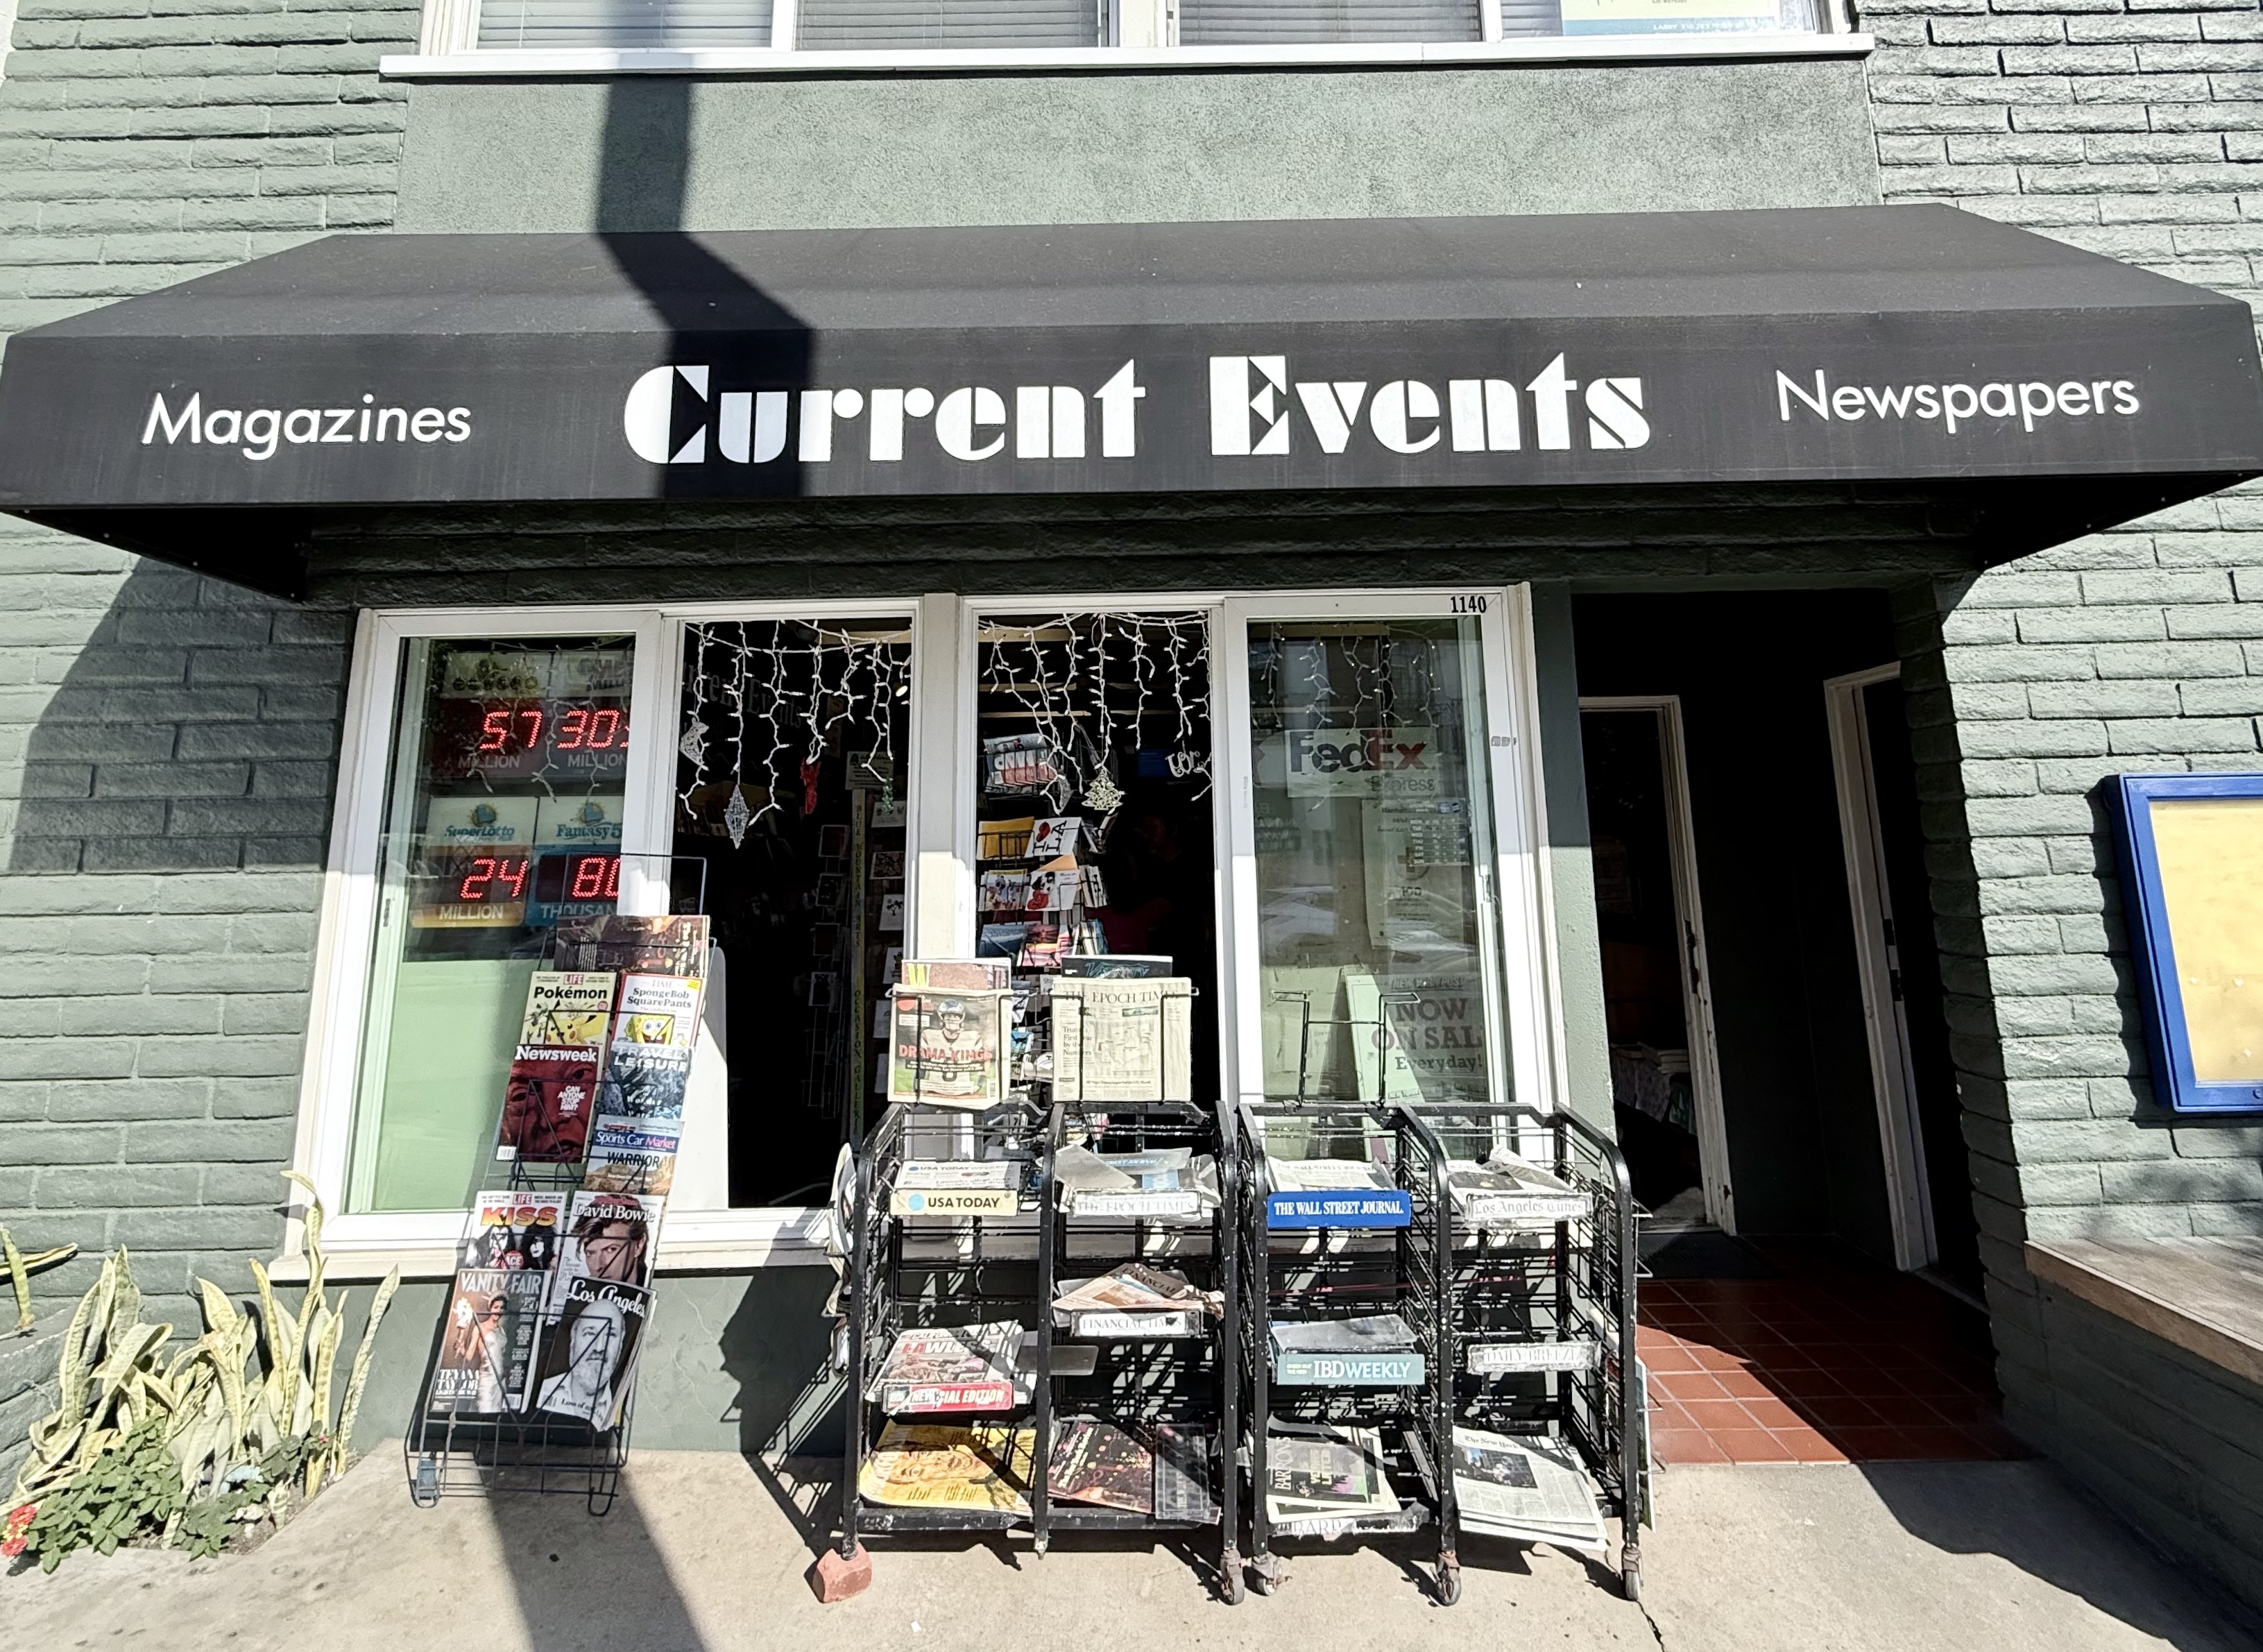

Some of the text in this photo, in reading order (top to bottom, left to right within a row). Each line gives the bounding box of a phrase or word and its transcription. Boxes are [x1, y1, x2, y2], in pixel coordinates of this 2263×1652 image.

[624, 352, 1650, 464] Current Events
[1776, 369, 2141, 434] Newspapers
[142, 392, 471, 461] Magazines
[1450, 595, 1487, 615] 1140
[1290, 729, 1428, 772] FedEx
[458, 754, 520, 769] MILLION
[460, 858, 528, 899] 24
[439, 905, 504, 920] MILLION
[564, 975, 583, 985] LIFE
[534, 987, 607, 999] Pokémon
[633, 988, 690, 998] SpongeBob
[1092, 992, 1136, 1003] EPOCH
[627, 996, 692, 1007] SquarePants
[1396, 998, 1468, 1021] NOW
[1372, 1028, 1417, 1050] ON
[515, 1046, 597, 1062] Newsweek
[898, 1045, 993, 1060] DRAMA KINGS
[614, 1056, 688, 1072] LEISURE
[1395, 1055, 1483, 1071] Everyday!
[596, 1132, 625, 1146] Sports
[626, 1134, 644, 1146] Car
[645, 1136, 676, 1149] Market
[607, 1152, 660, 1168] WARRIOR
[513, 1195, 531, 1204] LIFE
[928, 1198, 1000, 1208] USA TODAY
[573, 1202, 655, 1223] David Bowie
[1274, 1202, 1295, 1216] THE
[1297, 1202, 1322, 1215] WALL
[1323, 1201, 1360, 1215] STREET
[1474, 1201, 1584, 1215] Los Angeles Times
[481, 1207, 558, 1227] KISS
[461, 1272, 542, 1294] VANITY FAIR
[1121, 1268, 1177, 1293] FINANCIAL
[567, 1280, 645, 1317] Los Angeles
[1082, 1319, 1141, 1329] FINANCIAL
[1486, 1348, 1578, 1363] DAILY BREEZE
[438, 1380, 478, 1390] TAYOR
